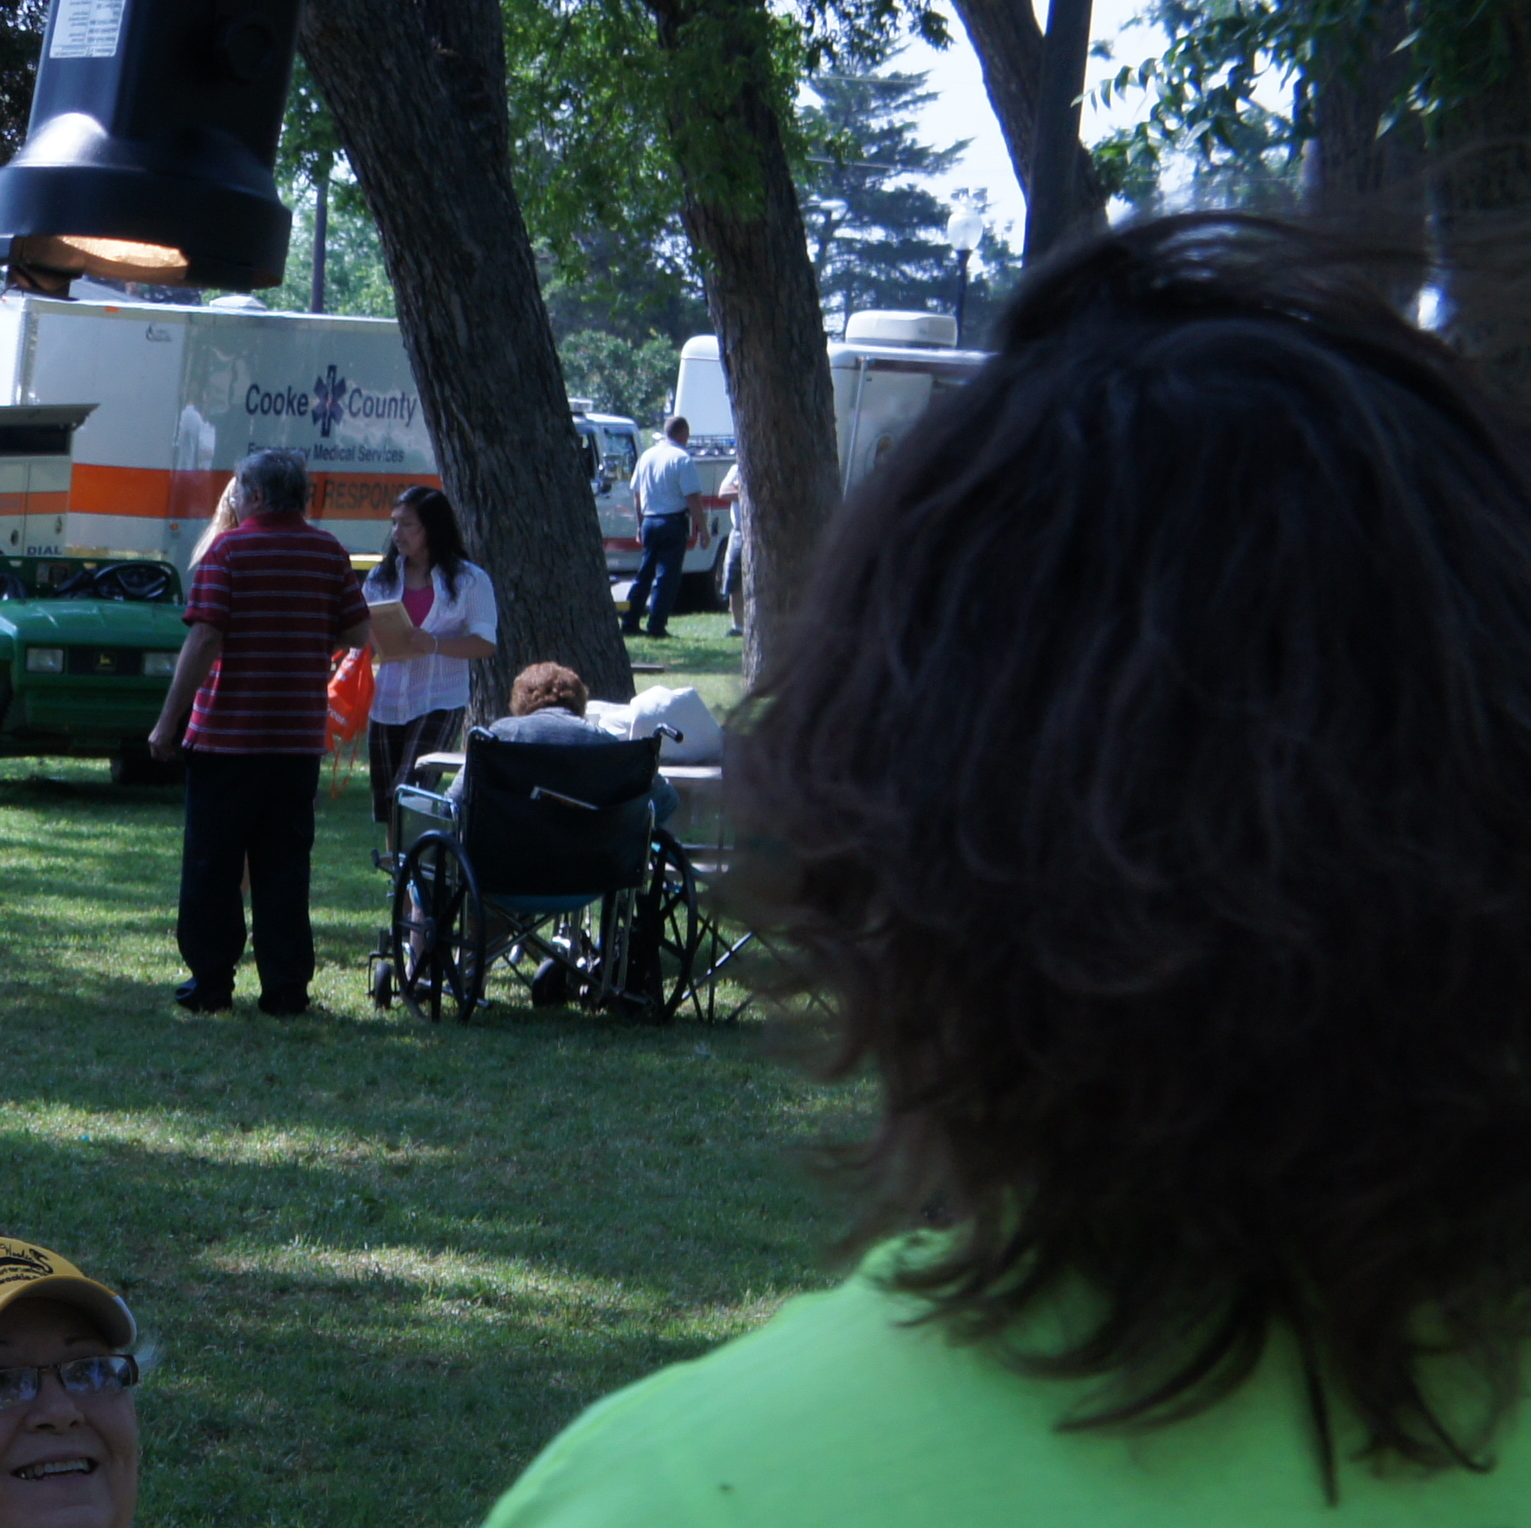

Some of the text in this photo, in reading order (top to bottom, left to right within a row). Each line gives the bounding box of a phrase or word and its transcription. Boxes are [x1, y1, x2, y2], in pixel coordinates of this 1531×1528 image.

[245, 383, 418, 428] Cooke County
[313, 442, 356, 462] Medical
[358, 443, 405, 463] Services
[26, 545, 64, 557] DIAL
